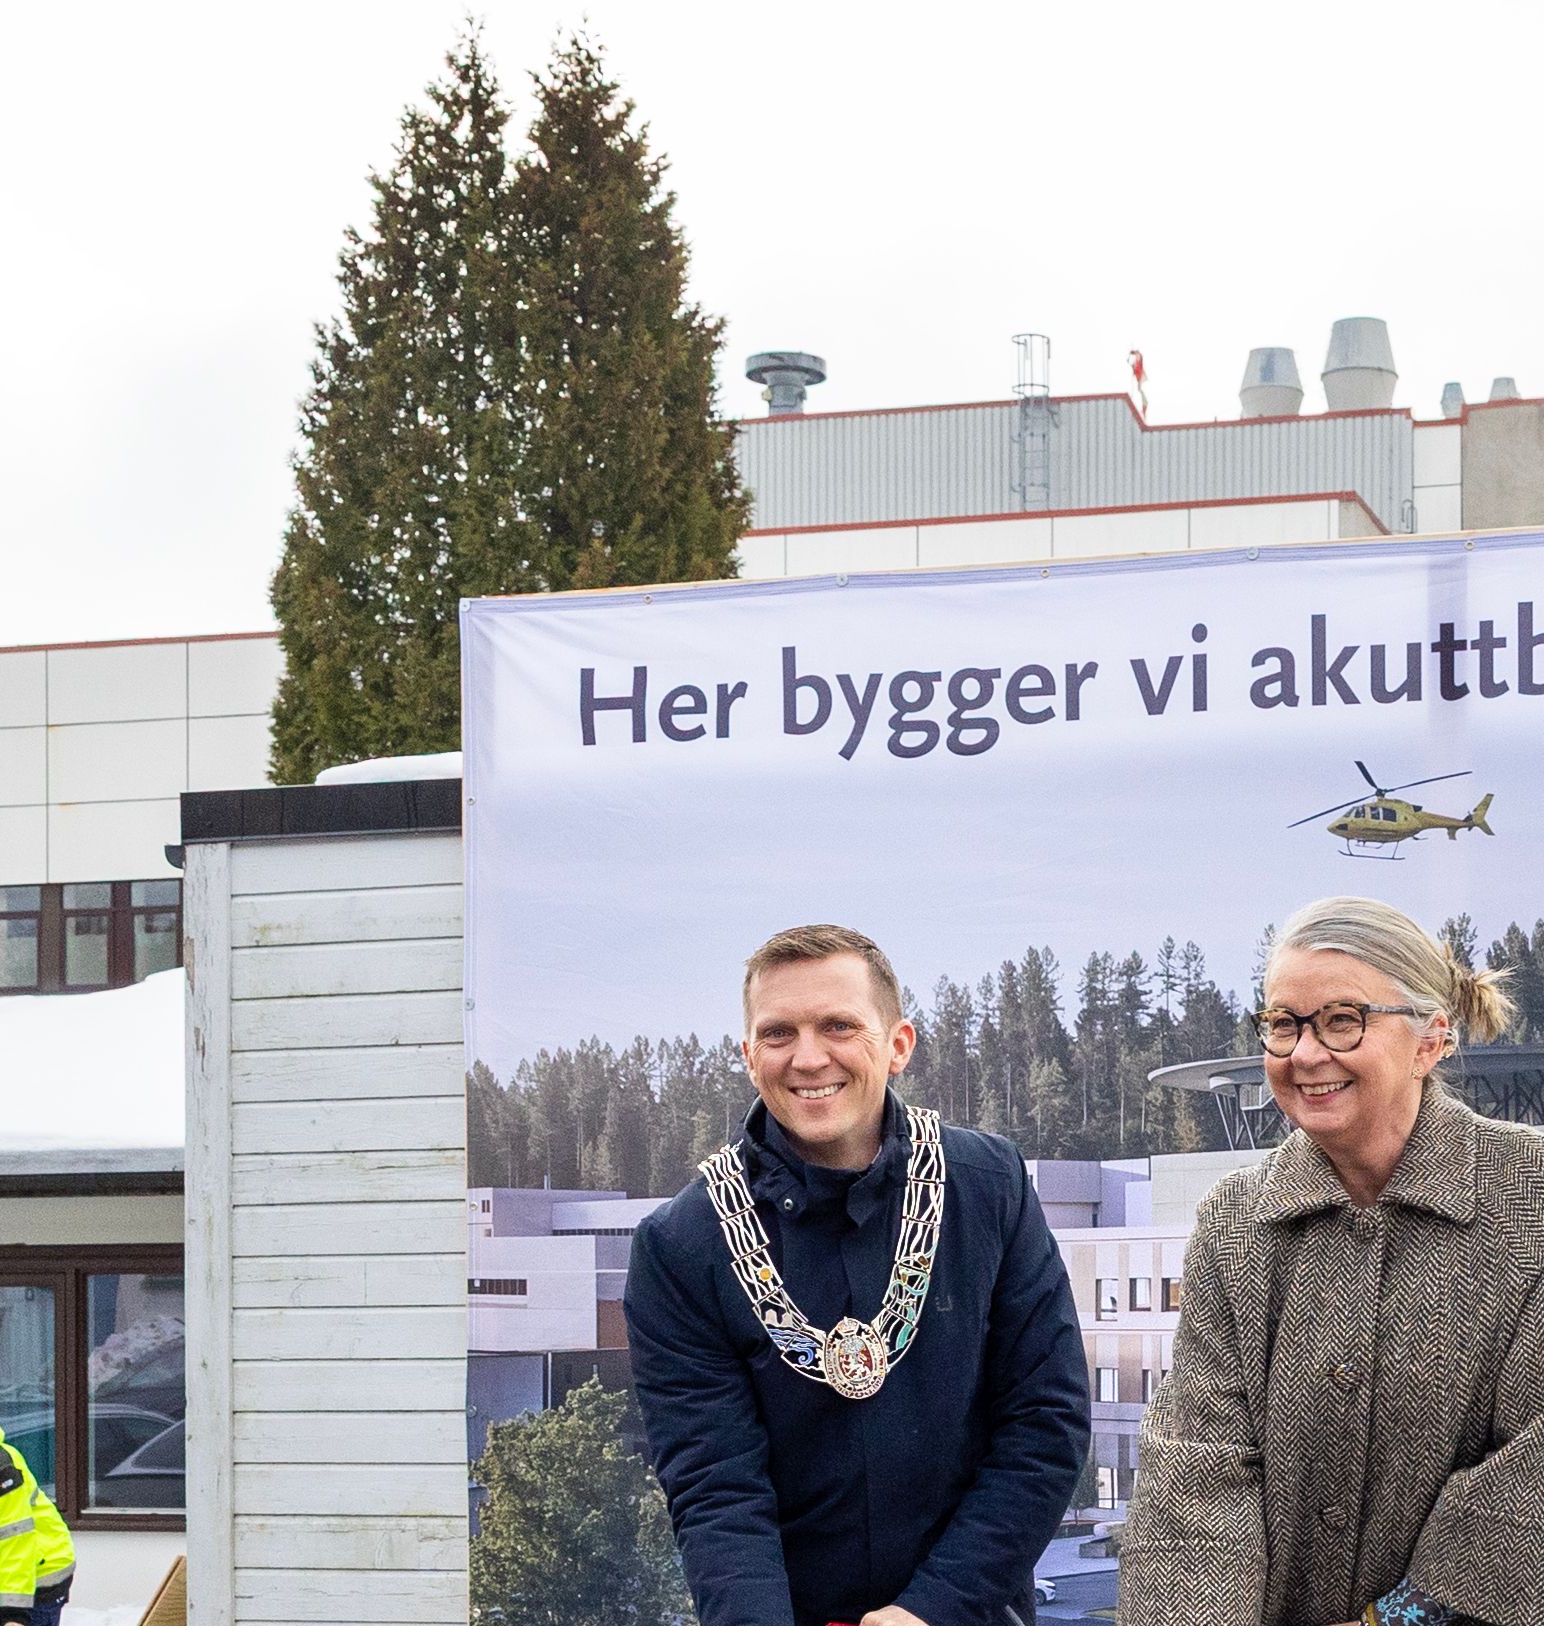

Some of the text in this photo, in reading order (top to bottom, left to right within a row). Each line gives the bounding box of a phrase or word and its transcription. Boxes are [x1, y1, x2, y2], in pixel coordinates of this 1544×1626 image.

[580, 665, 749, 746] Her
[782, 646, 1099, 761] bygger
[1130, 623, 1208, 716] vi
